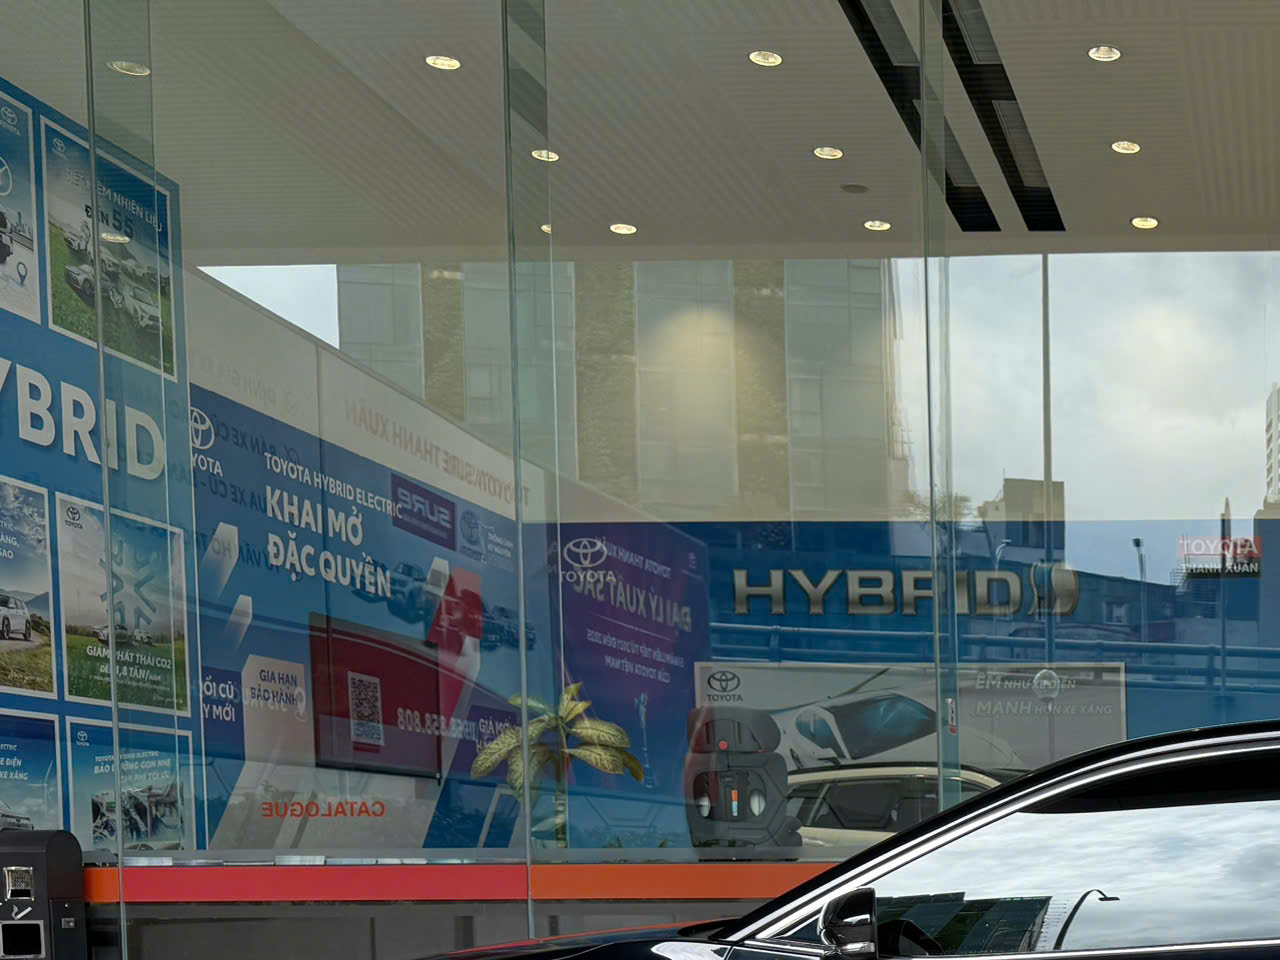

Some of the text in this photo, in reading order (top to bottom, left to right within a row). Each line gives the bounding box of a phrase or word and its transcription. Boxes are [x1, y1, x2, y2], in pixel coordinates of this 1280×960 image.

[0, 357, 165, 480] BRID
[264, 452, 404, 520] TOYOTA HYBRID ELECTRIC
[65, 519, 83, 530] TOYOTA
[265, 485, 324, 536] KHAI
[327, 505, 364, 547] MỞ
[1178, 538, 1259, 555] TOYOTA
[267, 529, 316, 582] ĐẶC
[319, 551, 393, 598] QUYỀN
[155, 657, 172, 670] CO2
[202, 675, 217, 696] ỔI
[219, 680, 235, 701] CŨ
[259, 668, 298, 690] GIA HẠN
[250, 683, 271, 701] BẢO
[707, 694, 744, 702] TOYOTA
[212, 702, 236, 722] MỚI
[6, 756, 22, 768] ĐIỆN
